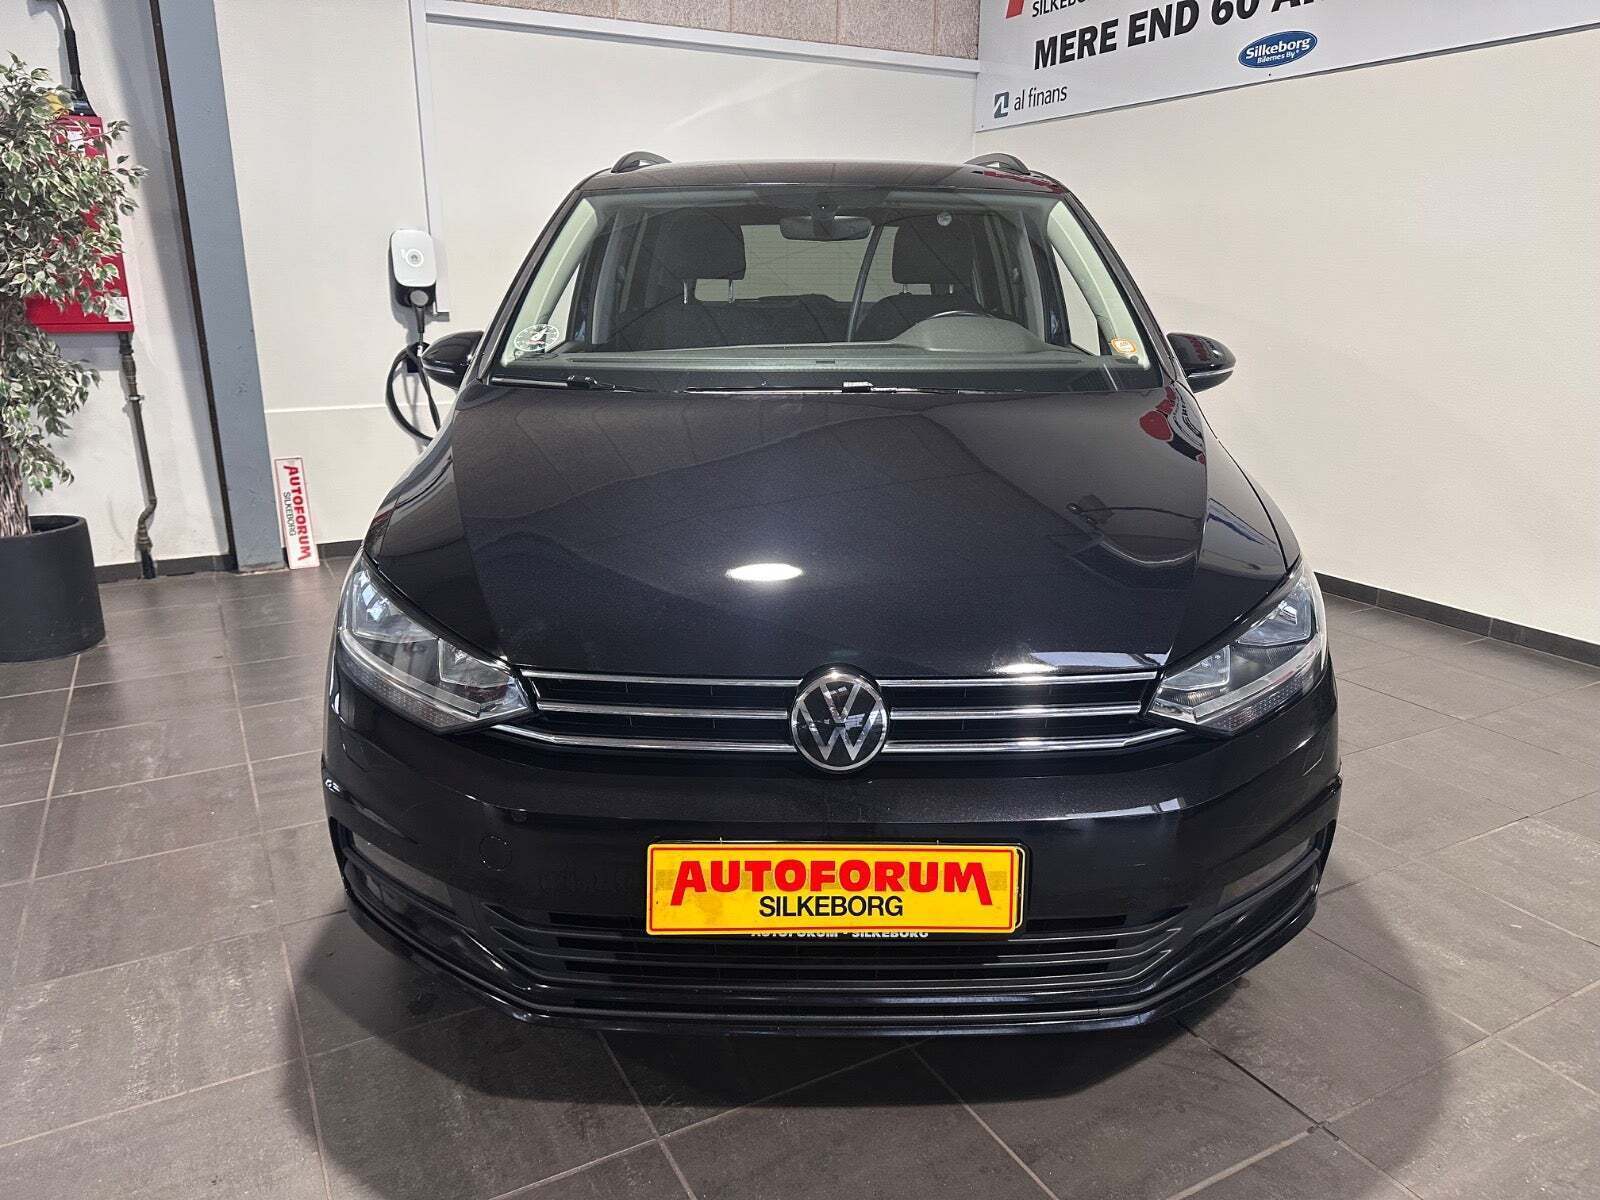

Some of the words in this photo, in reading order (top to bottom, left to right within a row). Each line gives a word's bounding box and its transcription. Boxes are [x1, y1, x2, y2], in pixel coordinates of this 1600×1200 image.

[1032, 0, 1086, 17] SILKE
[1034, 19, 1119, 70] MERE
[1128, 0, 1200, 47] END
[1211, 0, 1259, 25] 60
[1246, 38, 1311, 59] Silkeborg
[1014, 89, 1025, 110] al
[1028, 86, 1067, 107] finans
[283, 465, 311, 560] AUTOFORUM
[283, 491, 296, 536] SILKEBORG
[670, 859, 993, 906] AUTOFORUM
[759, 895, 903, 917] SILKEBORG
